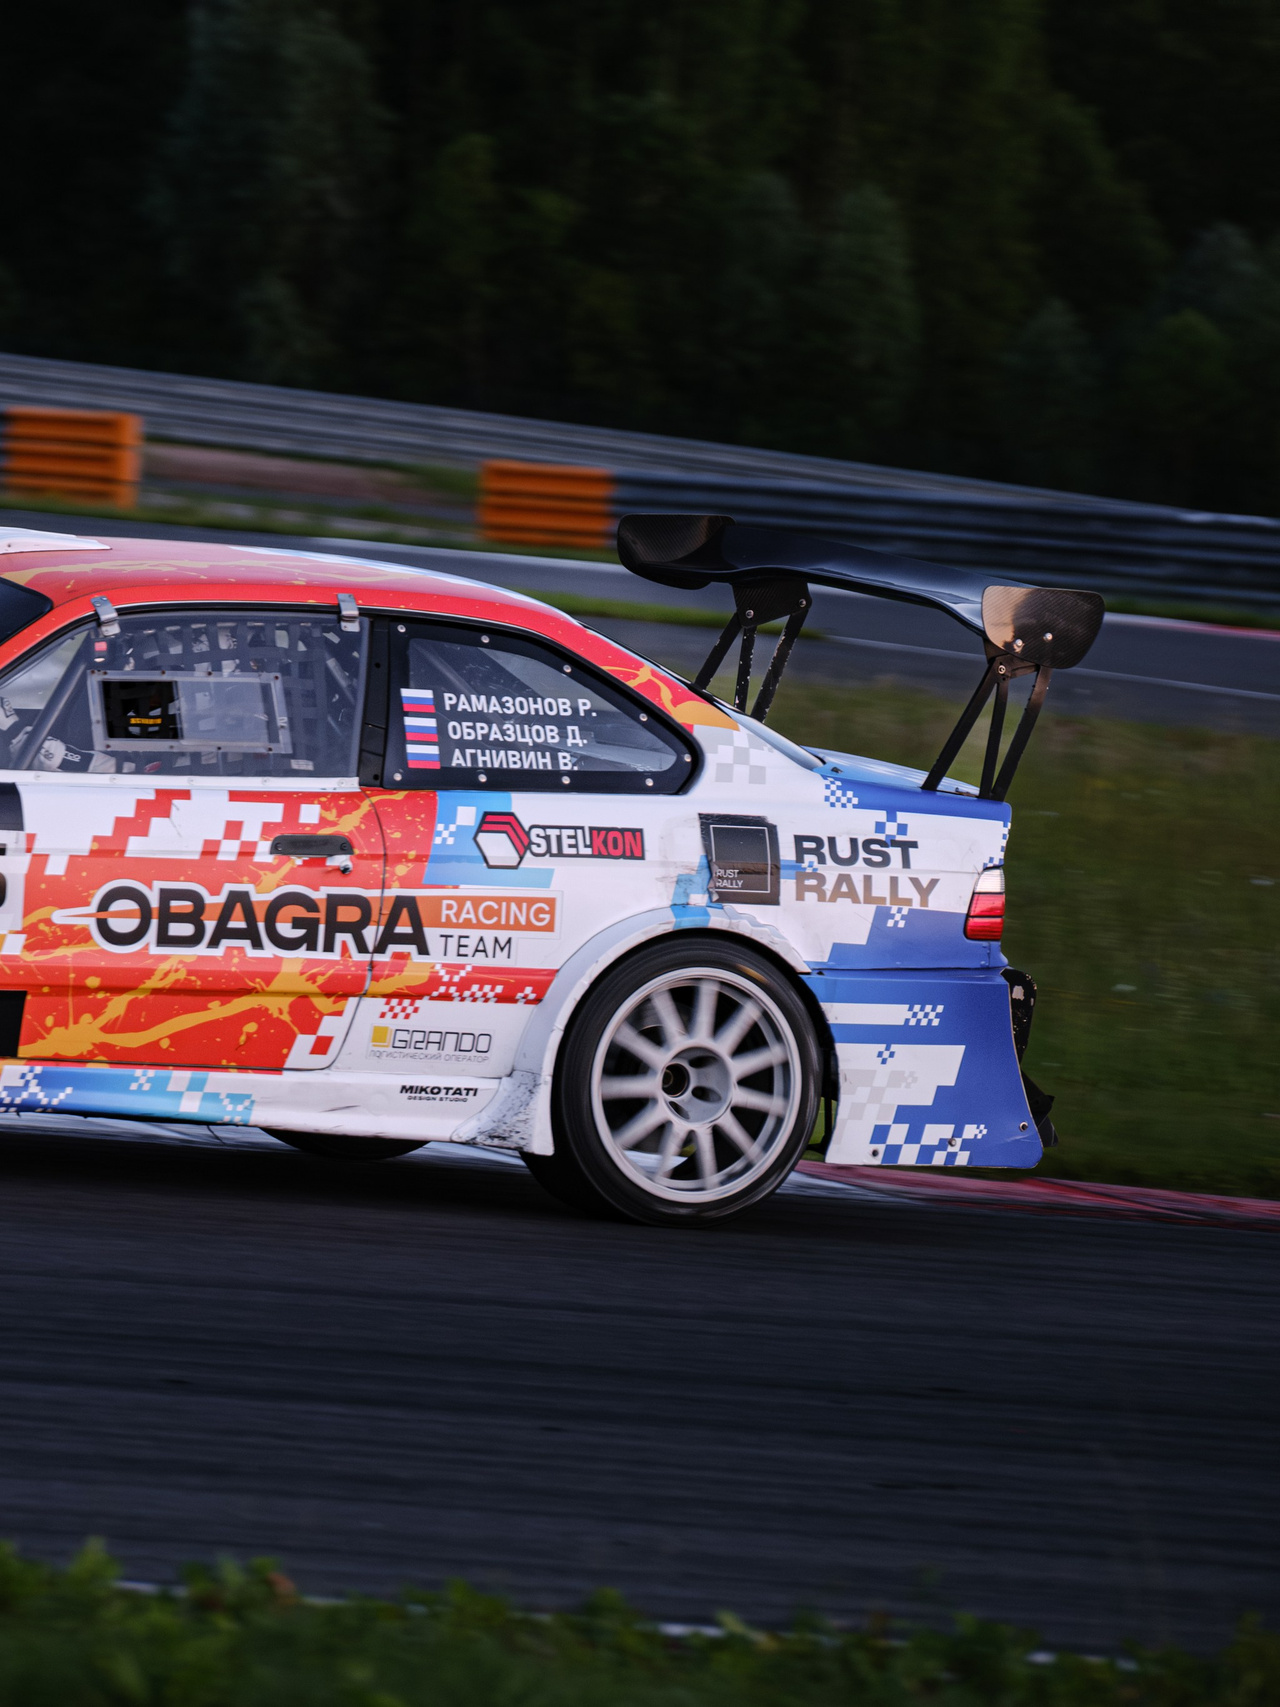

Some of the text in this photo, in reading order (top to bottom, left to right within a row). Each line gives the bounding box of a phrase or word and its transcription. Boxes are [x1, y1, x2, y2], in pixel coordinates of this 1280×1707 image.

[442, 692, 598, 717] РАМАЗОНОВ Р.
[447, 721, 588, 746] ОБРАЗЦОВ Д.
[451, 748, 578, 770] АГНИВИН В.
[528, 827, 643, 858] STELKON
[793, 834, 919, 869] RUST
[716, 868, 739, 878] RUST
[716, 879, 743, 888] RALLY
[794, 871, 940, 908] RALLY
[96, 885, 430, 956] OBAGRA
[440, 899, 551, 926] RACING
[439, 933, 512, 959] TEAM
[392, 1028, 492, 1053] GRANDO
[400, 1085, 478, 1097] MIKOTATI
